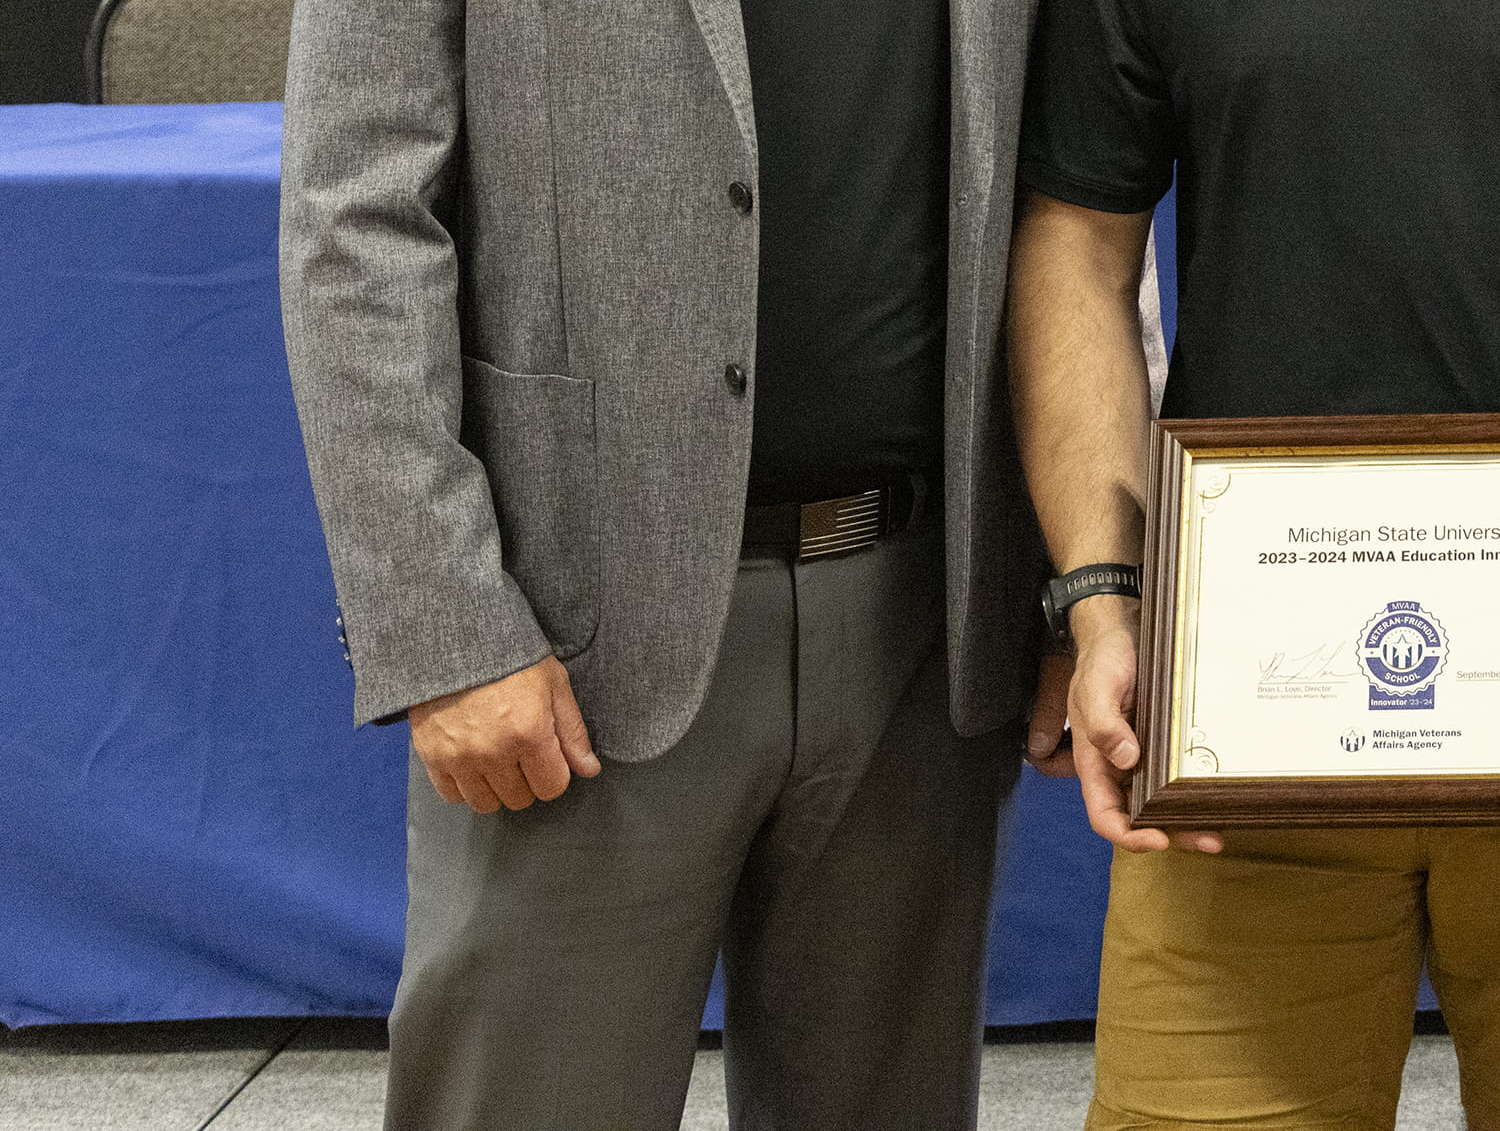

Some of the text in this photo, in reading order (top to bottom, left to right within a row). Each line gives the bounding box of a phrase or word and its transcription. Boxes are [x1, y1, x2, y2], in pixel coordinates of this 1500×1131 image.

[1288, 527, 1371, 546] Michigan
[1377, 525, 1427, 542] State
[1352, 550, 1396, 563] MVAA
[1401, 549, 1475, 562] Education
[1391, 602, 1416, 610] MVAA
[1368, 616, 1438, 646] VETERAN-FRIENDLY
[1384, 672, 1421, 684] SCHOOL
[1370, 698, 1408, 706] Innovator
[1372, 729, 1462, 739] Michigan Veterans
[1372, 741, 1443, 750] Affairs Agency
